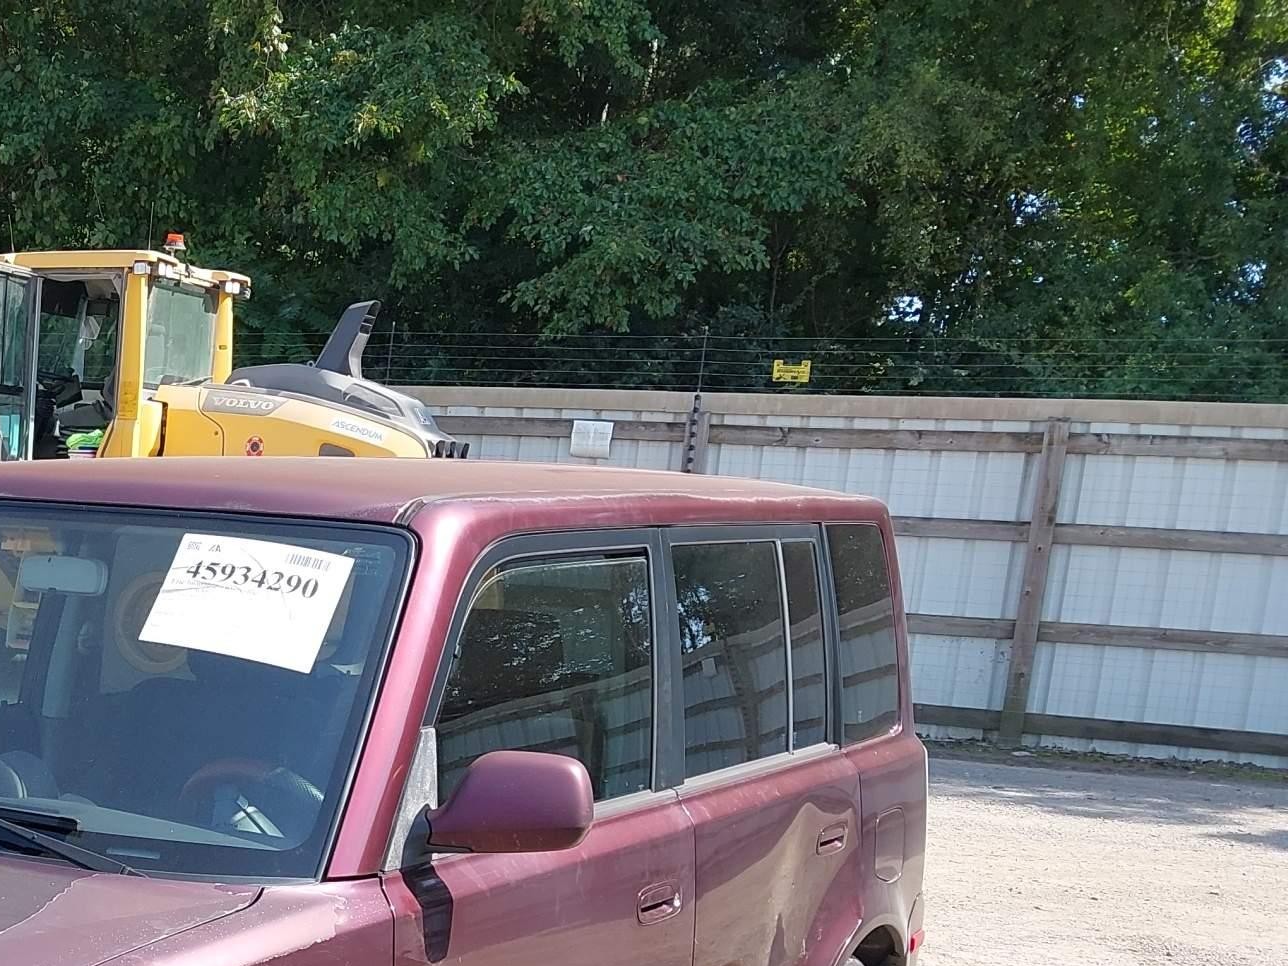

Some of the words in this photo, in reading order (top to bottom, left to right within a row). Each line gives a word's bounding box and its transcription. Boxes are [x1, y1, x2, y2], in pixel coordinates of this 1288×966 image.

[213, 397, 274, 410] VOLVO
[332, 419, 383, 441] ASCENDUM
[186, 560, 319, 599] 45934290
